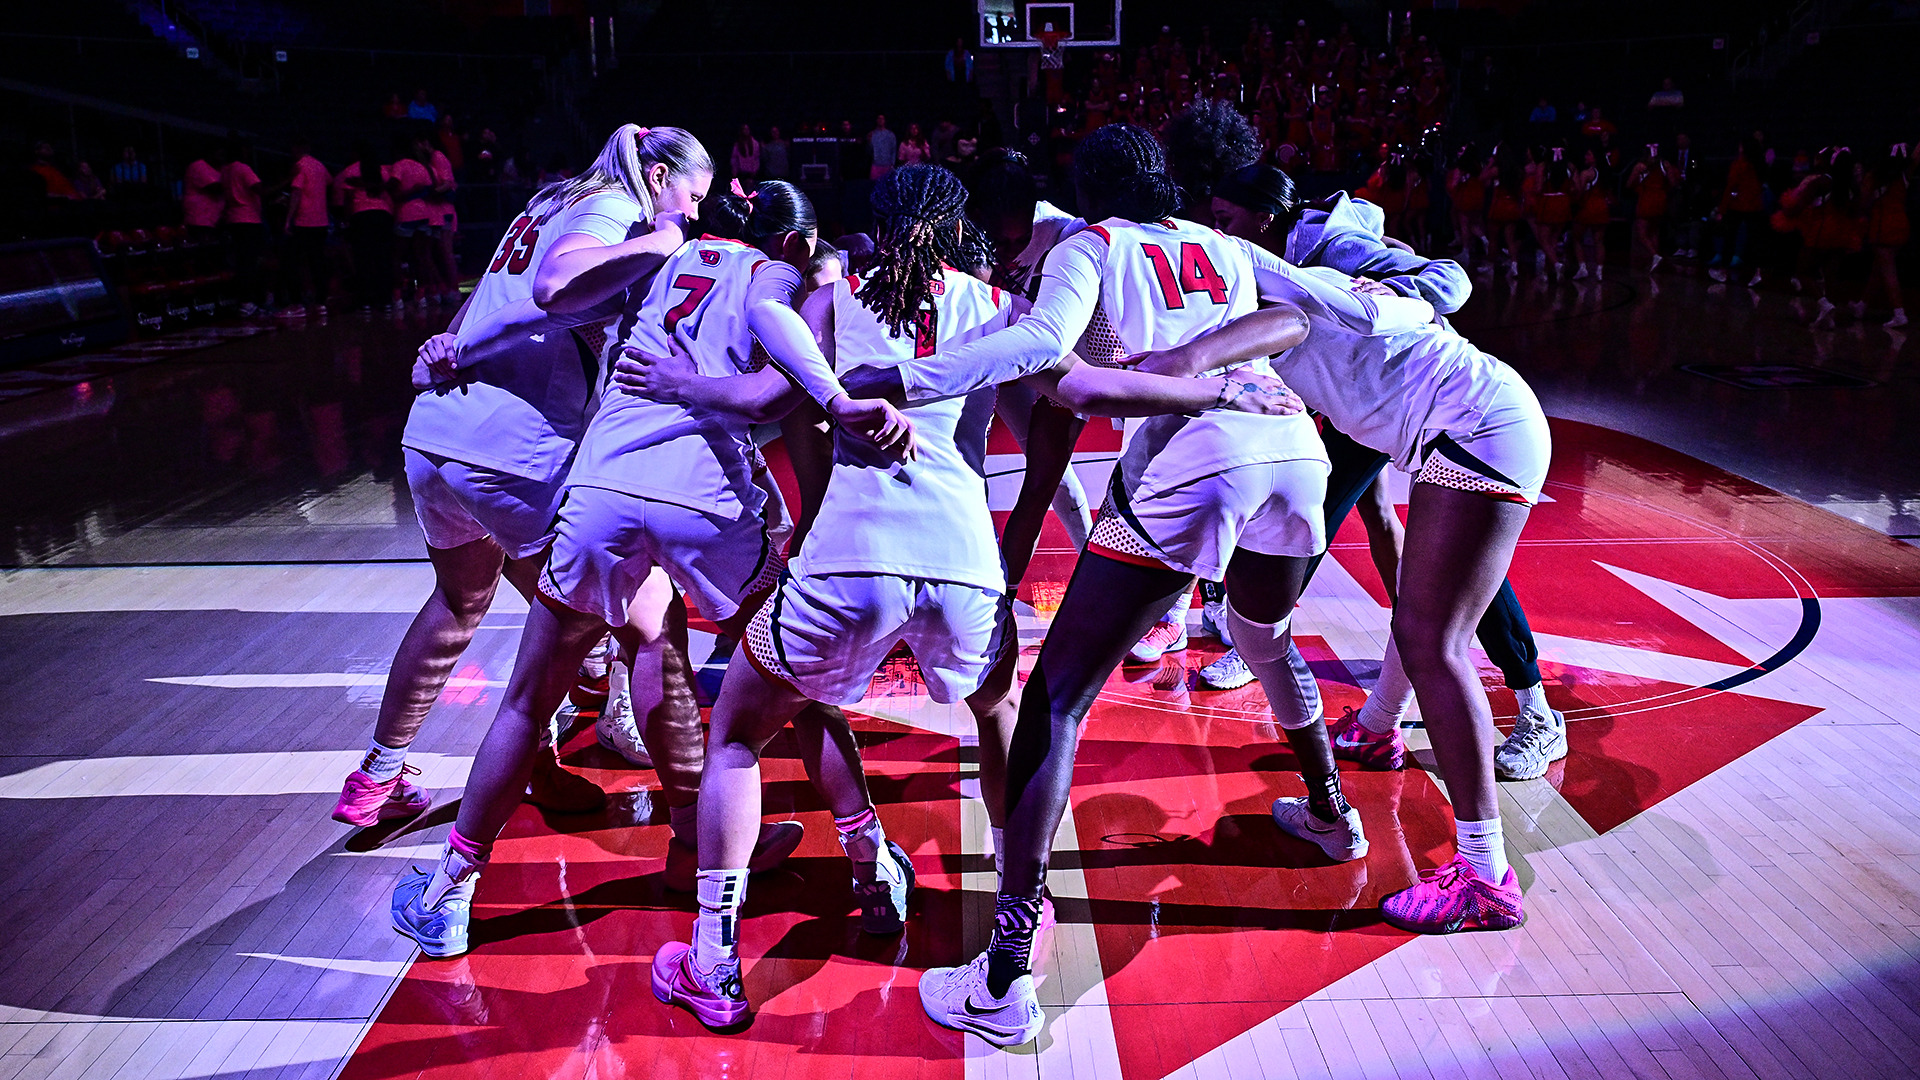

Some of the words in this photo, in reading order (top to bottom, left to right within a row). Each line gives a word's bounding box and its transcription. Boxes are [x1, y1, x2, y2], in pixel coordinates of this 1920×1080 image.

[489, 214, 545, 275] 35
[664, 273, 717, 334] 7
[1139, 241, 1229, 310] 14
